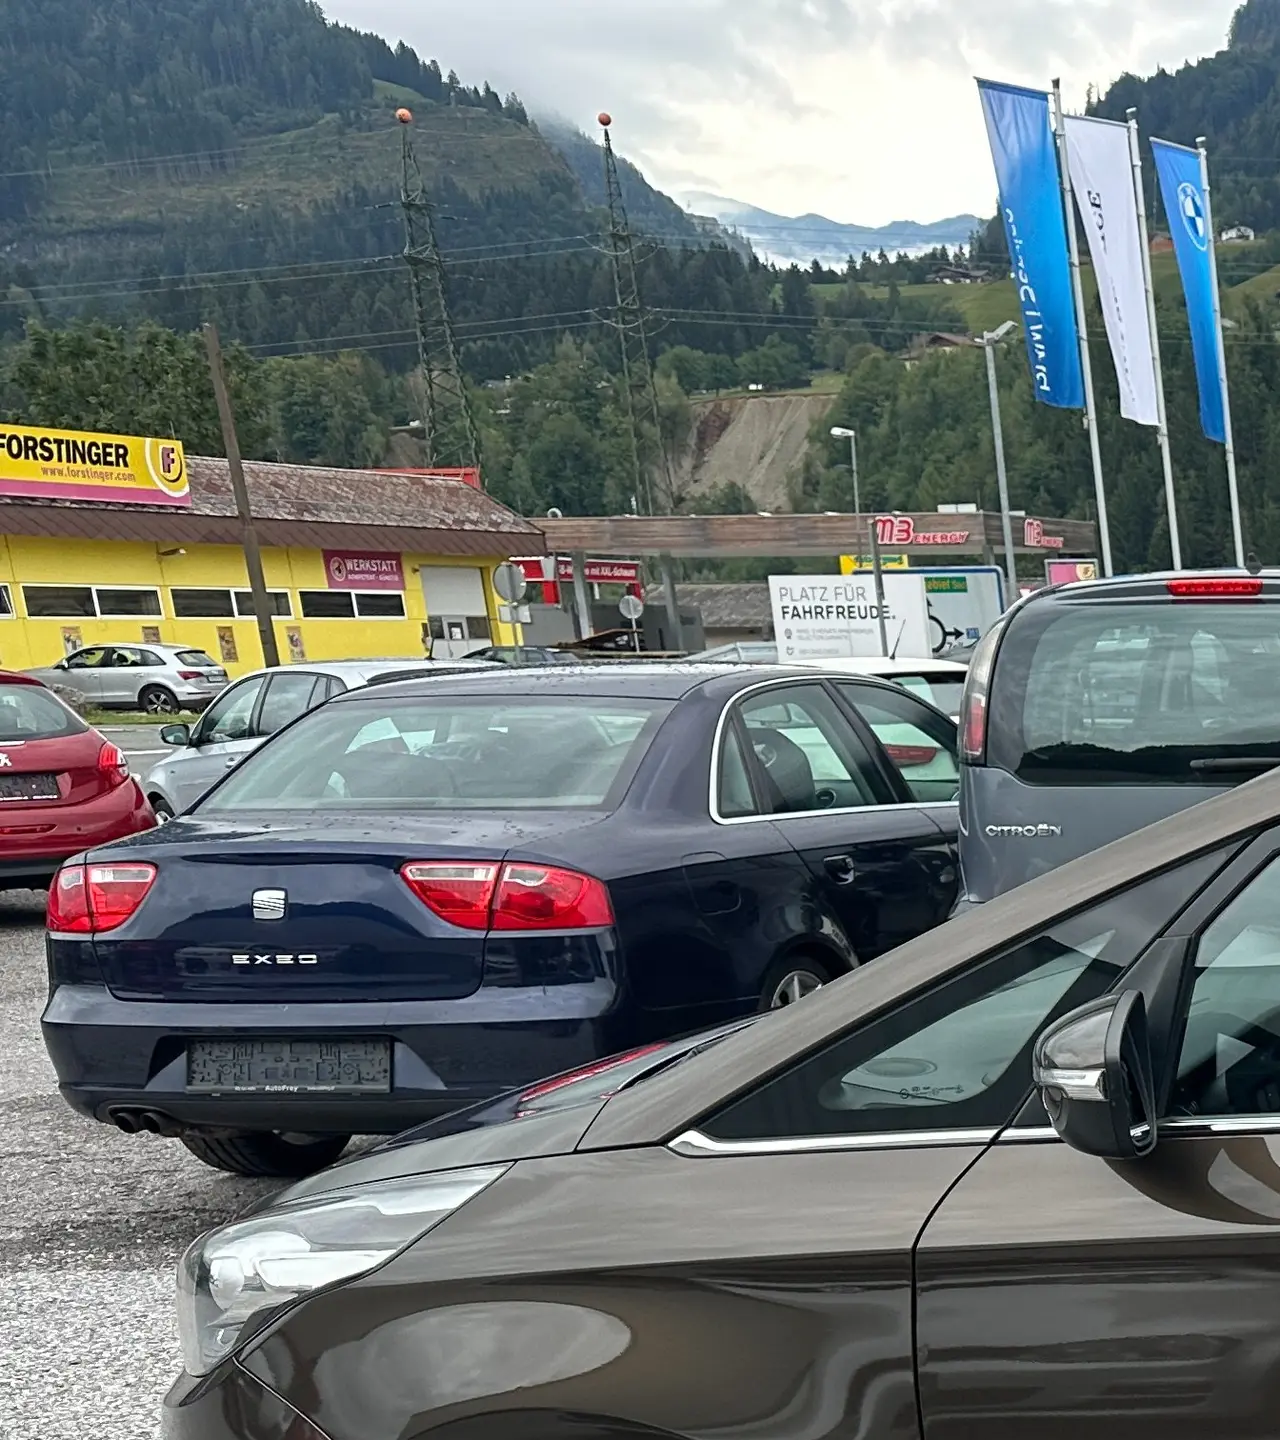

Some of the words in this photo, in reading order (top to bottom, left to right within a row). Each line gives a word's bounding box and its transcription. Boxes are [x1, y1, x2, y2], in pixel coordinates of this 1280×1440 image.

[41, 466, 137, 482] www.forstinger.com
[913, 532, 969, 544] ENERGY
[345, 559, 397, 572] WERKSTATT
[779, 586, 828, 602] PLATZ
[834, 584, 867, 602] FÜR
[781, 605, 896, 620] FAHRFREUDE.
[985, 823, 1062, 837] CITROËN
[232, 954, 317, 964] EXEO
